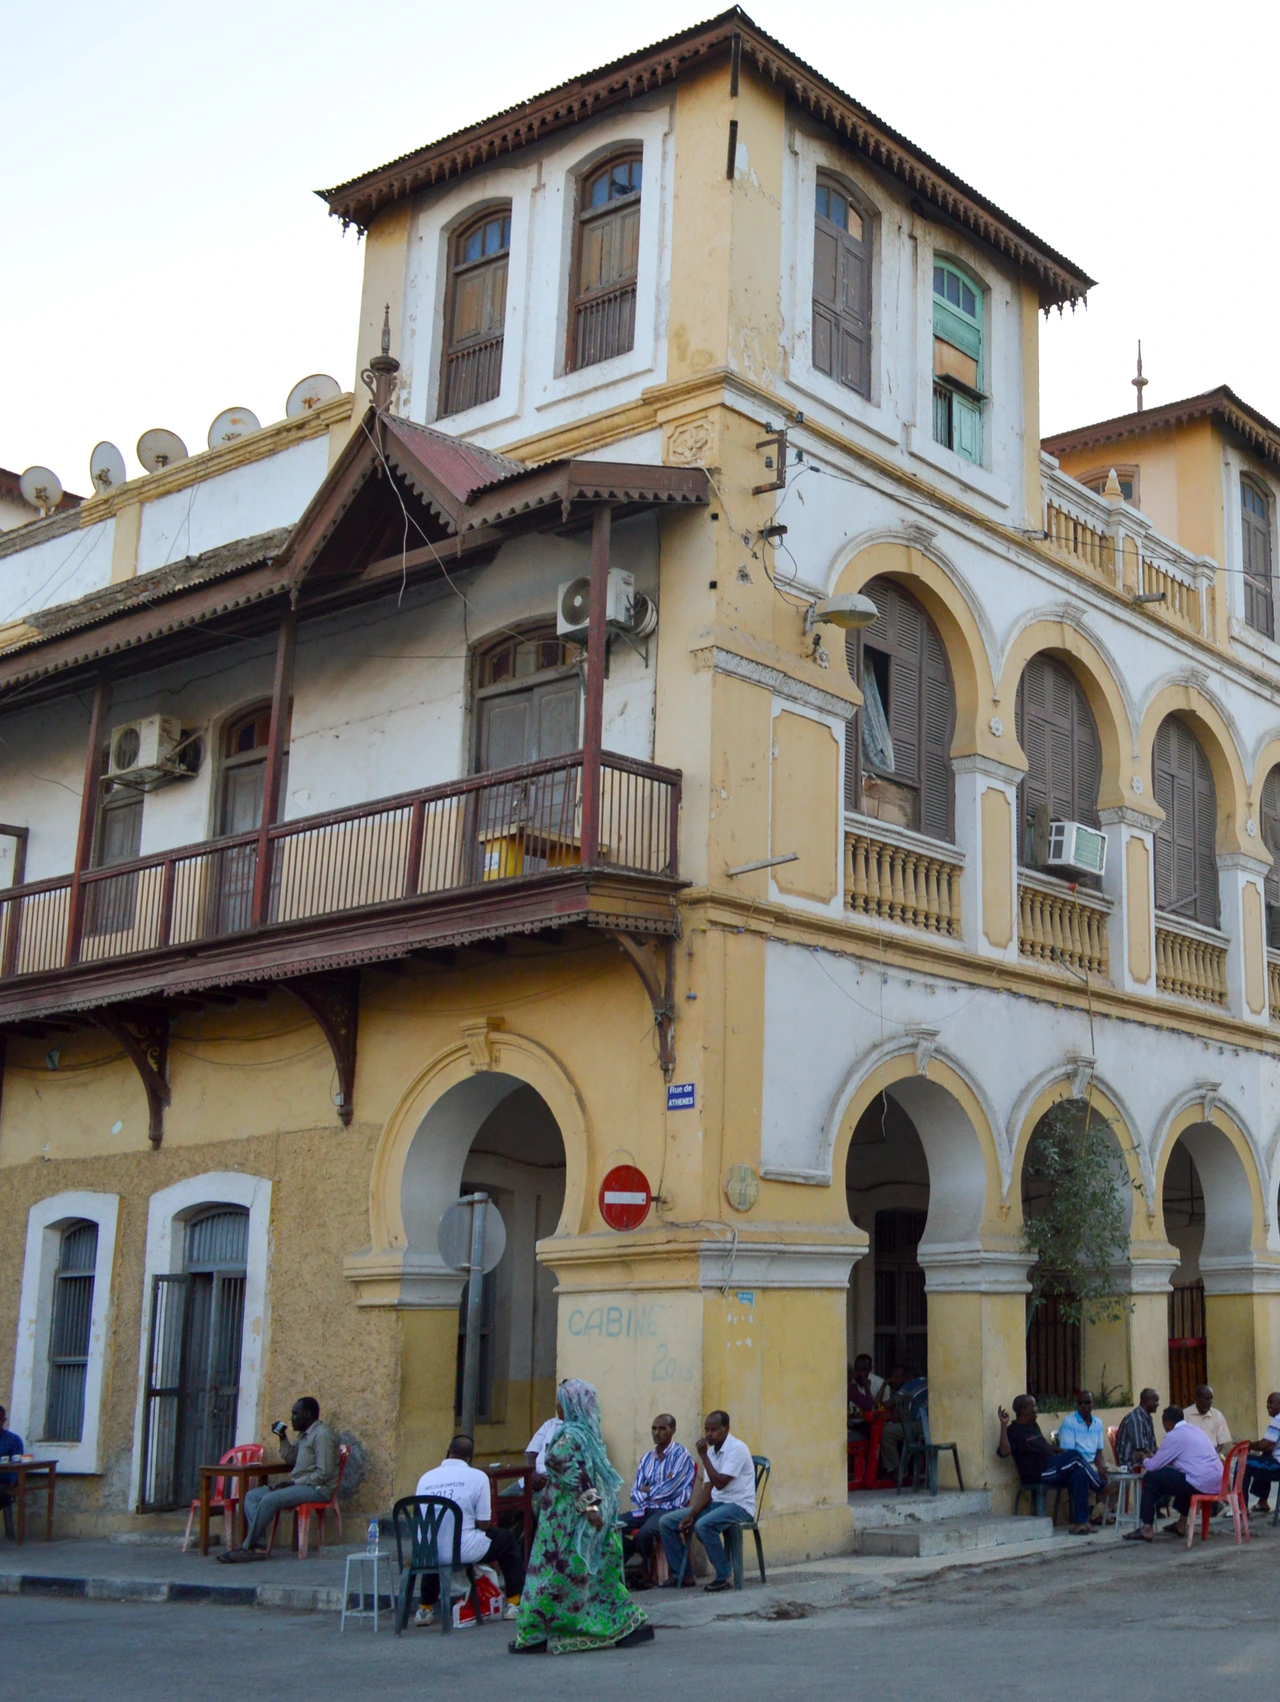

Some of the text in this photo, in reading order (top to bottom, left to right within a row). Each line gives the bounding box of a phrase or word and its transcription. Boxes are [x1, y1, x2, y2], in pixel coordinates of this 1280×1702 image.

[669, 1084, 693, 1094] Rue de
[668, 1097, 694, 1107] ATHENES
